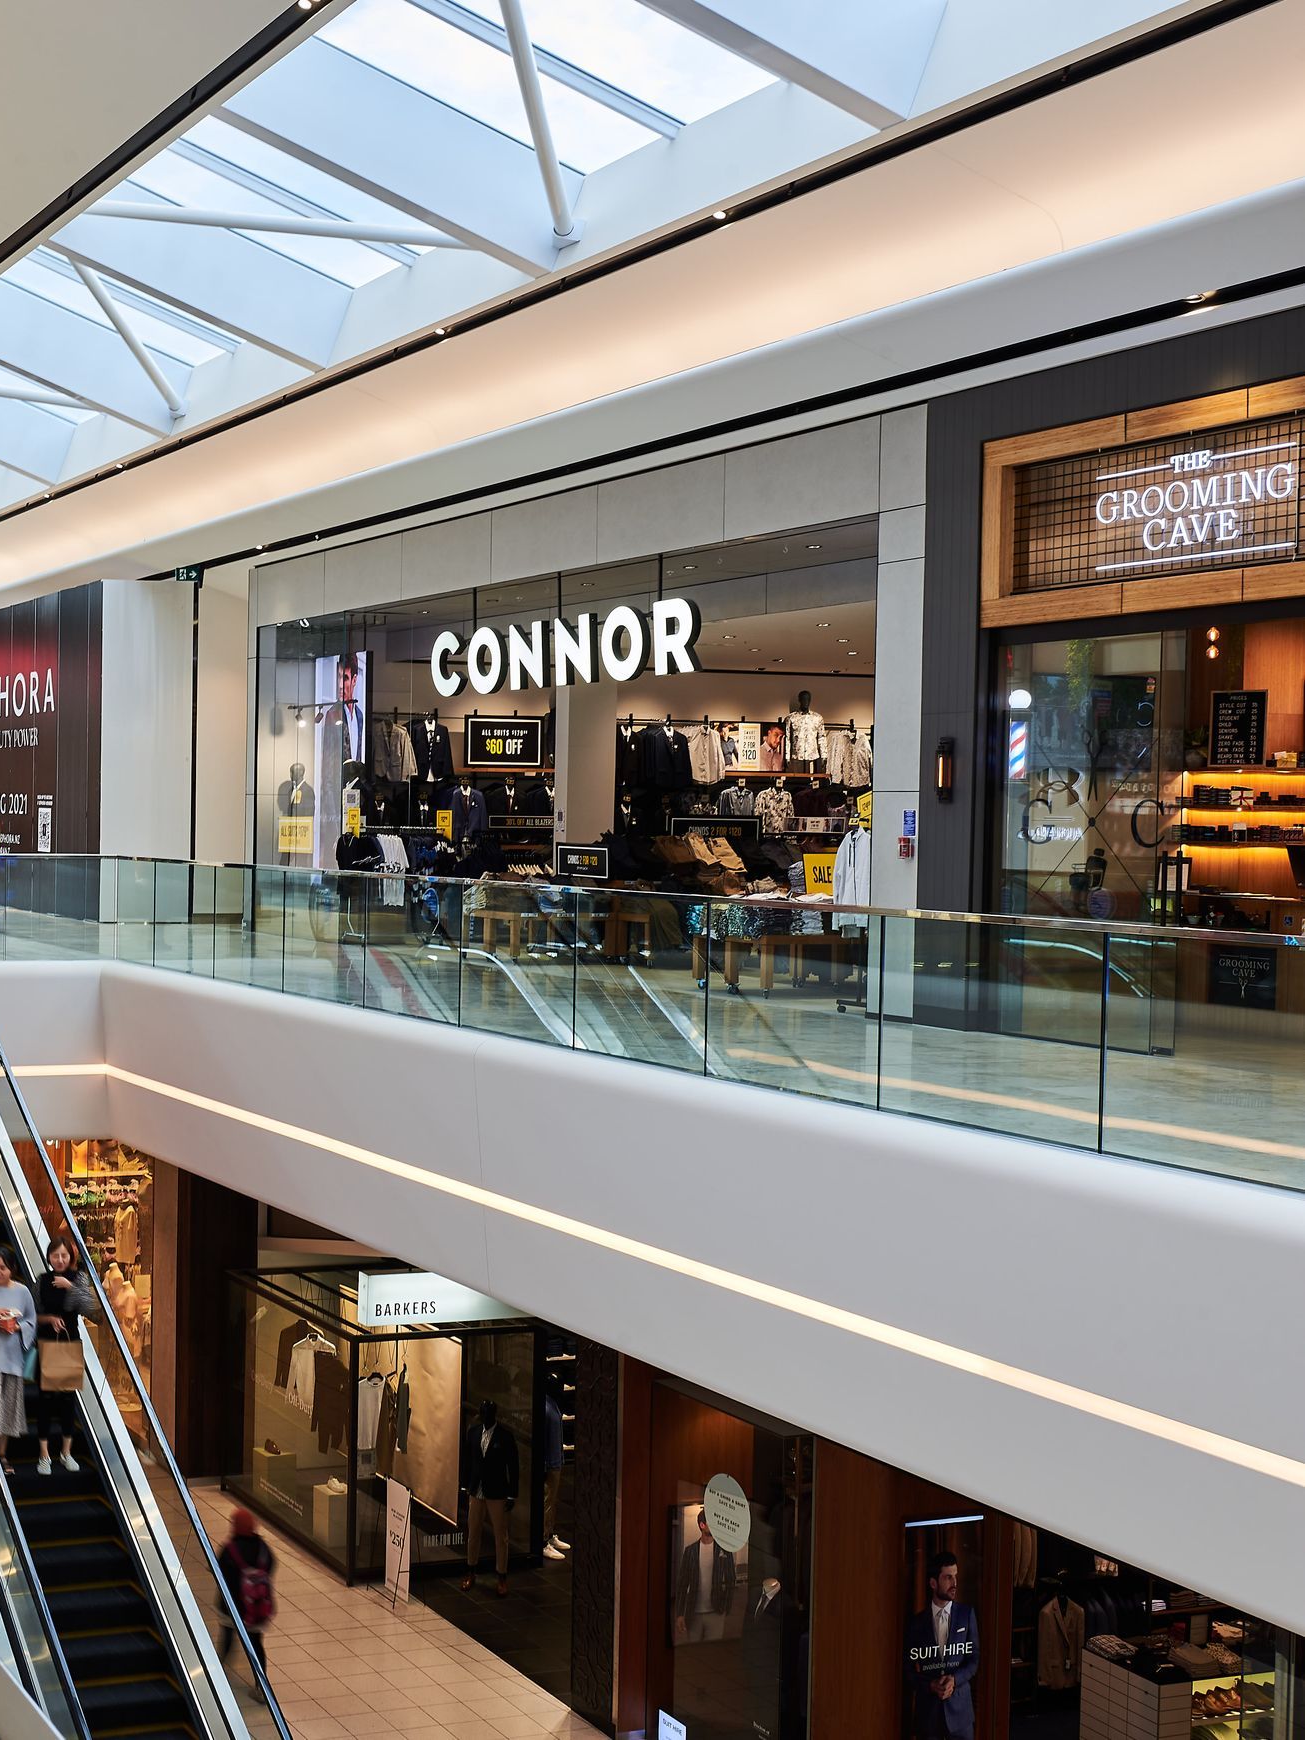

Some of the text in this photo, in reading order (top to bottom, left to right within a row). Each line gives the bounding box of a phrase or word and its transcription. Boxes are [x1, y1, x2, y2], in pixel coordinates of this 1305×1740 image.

[1170, 450, 1213, 474] THE
[1096, 463, 1296, 524] GROOMING
[1143, 508, 1240, 551] CAVE
[431, 597, 700, 697] CONNOR
[13, 727, 39, 748] POWER
[493, 729, 510, 737] SUITS
[486, 739, 524, 755] $60 OFF
[742, 750, 757, 760] $120
[9, 793, 28, 815] 2021
[526, 818, 534, 826] ALL
[535, 818, 554, 826] BLAZERS
[716, 826, 728, 836] FOR
[813, 866, 832, 883] SALE
[1219, 958, 1270, 970] GROOMING
[1232, 968, 1256, 978] CAVE
[375, 1301, 436, 1317] BARKERS
[910, 1641, 973, 1660] SUIT HIRE
